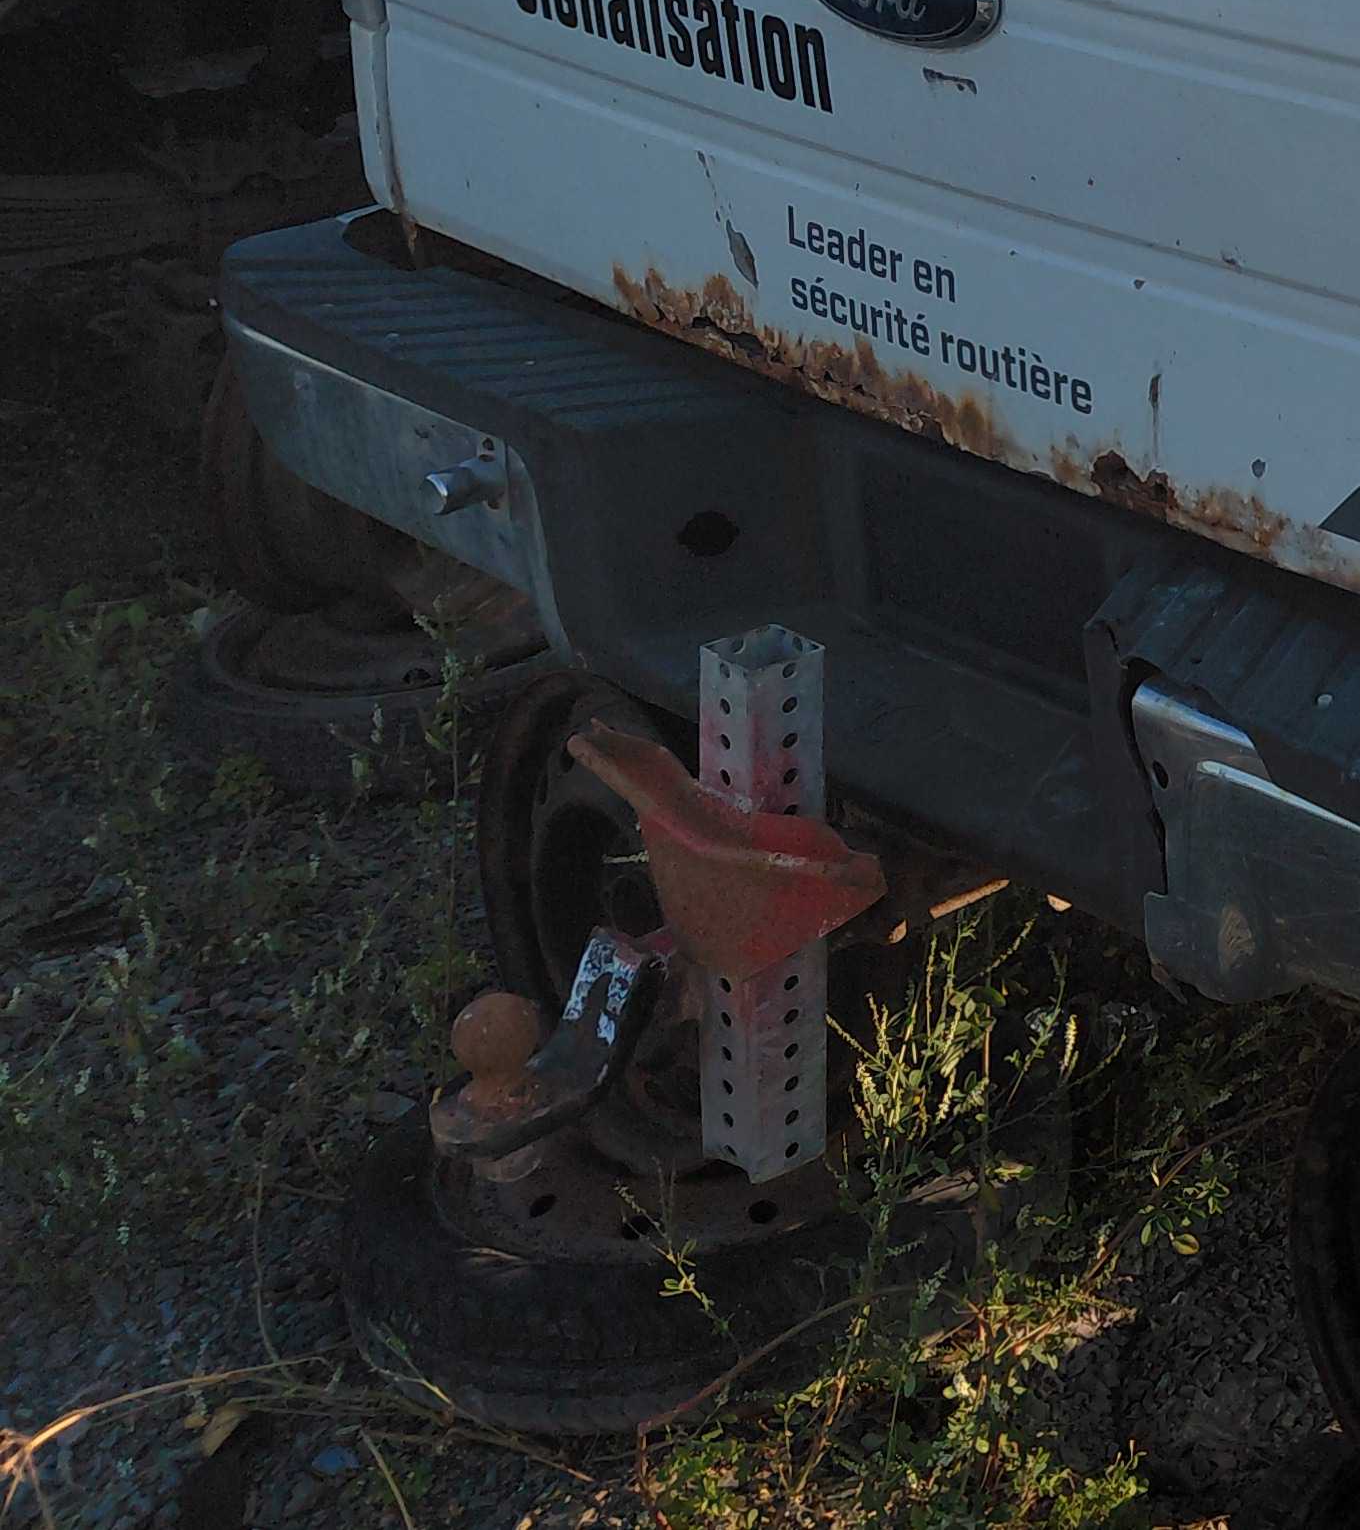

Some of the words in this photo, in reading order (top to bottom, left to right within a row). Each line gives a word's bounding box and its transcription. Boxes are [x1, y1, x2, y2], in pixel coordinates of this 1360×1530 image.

[786, 205, 903, 283] Leader
[913, 258, 957, 303] en
[791, 277, 930, 356] sécurité
[941, 329, 1092, 414] routière
